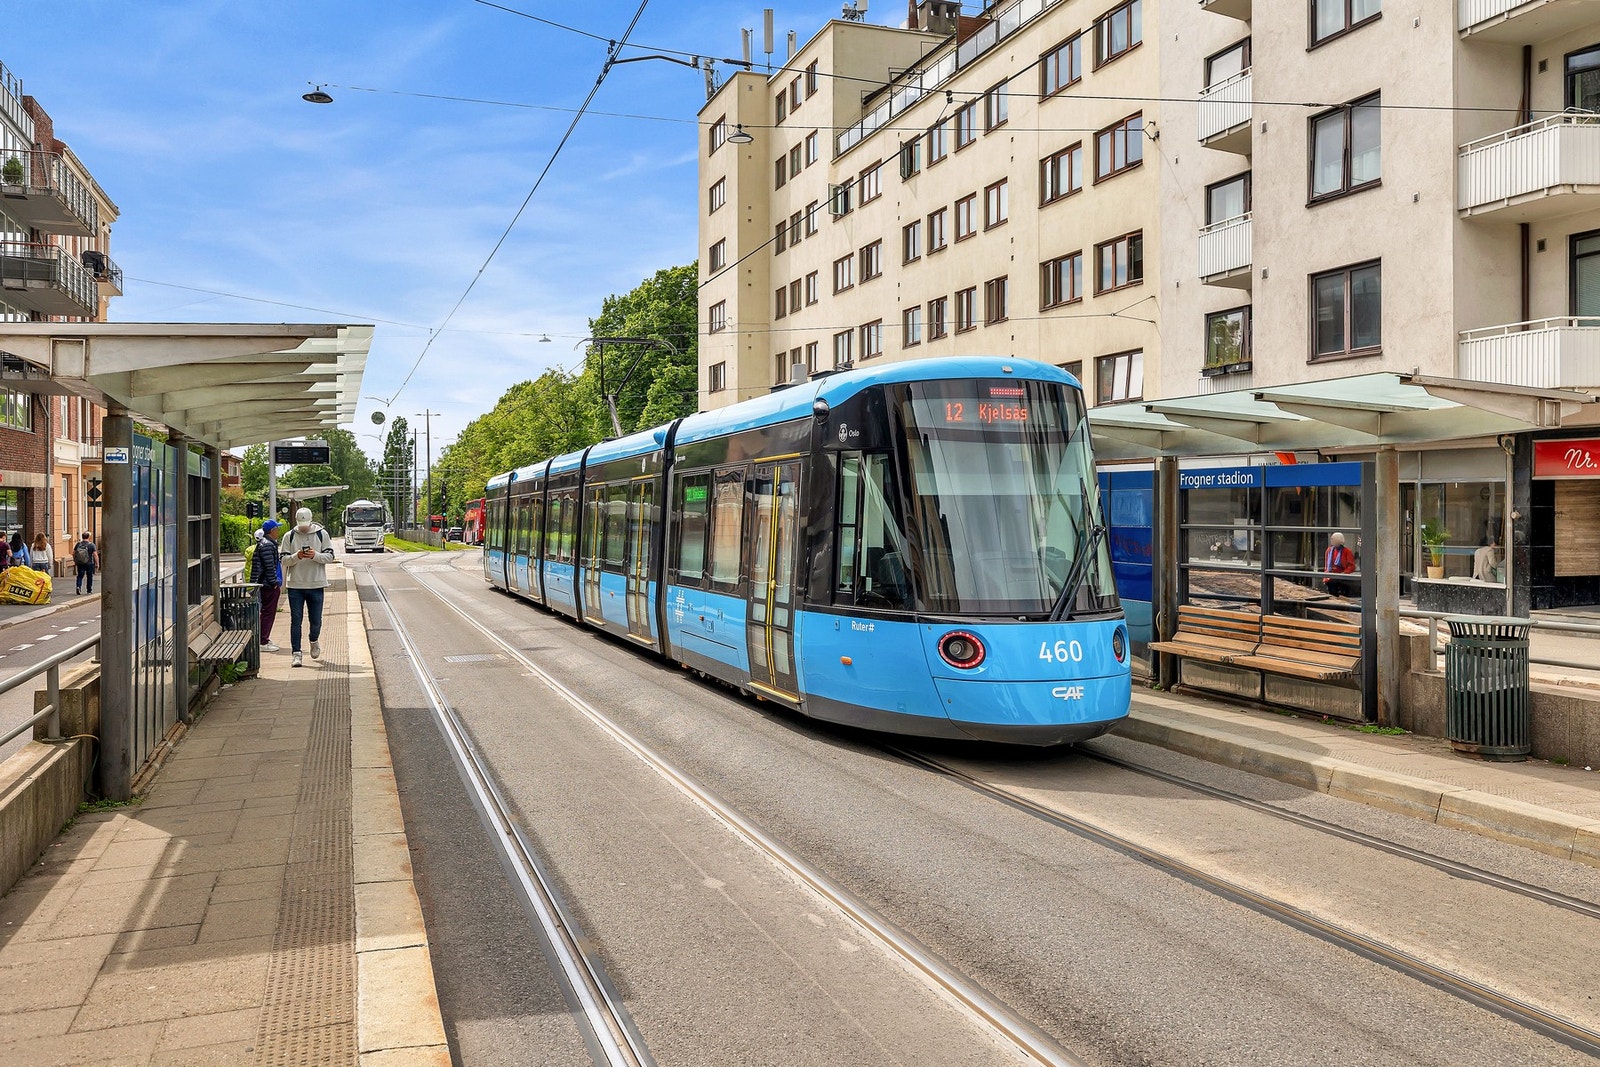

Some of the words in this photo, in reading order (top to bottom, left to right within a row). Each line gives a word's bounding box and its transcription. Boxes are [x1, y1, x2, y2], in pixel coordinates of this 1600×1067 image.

[945, 402, 964, 422] 12
[1564, 448, 1598, 469] Nr.
[1180, 473, 1215, 488] Frogner
[1217, 471, 1253, 485] stadion
[1039, 640, 1083, 663] 460
[1052, 686, 1084, 700] CAF
